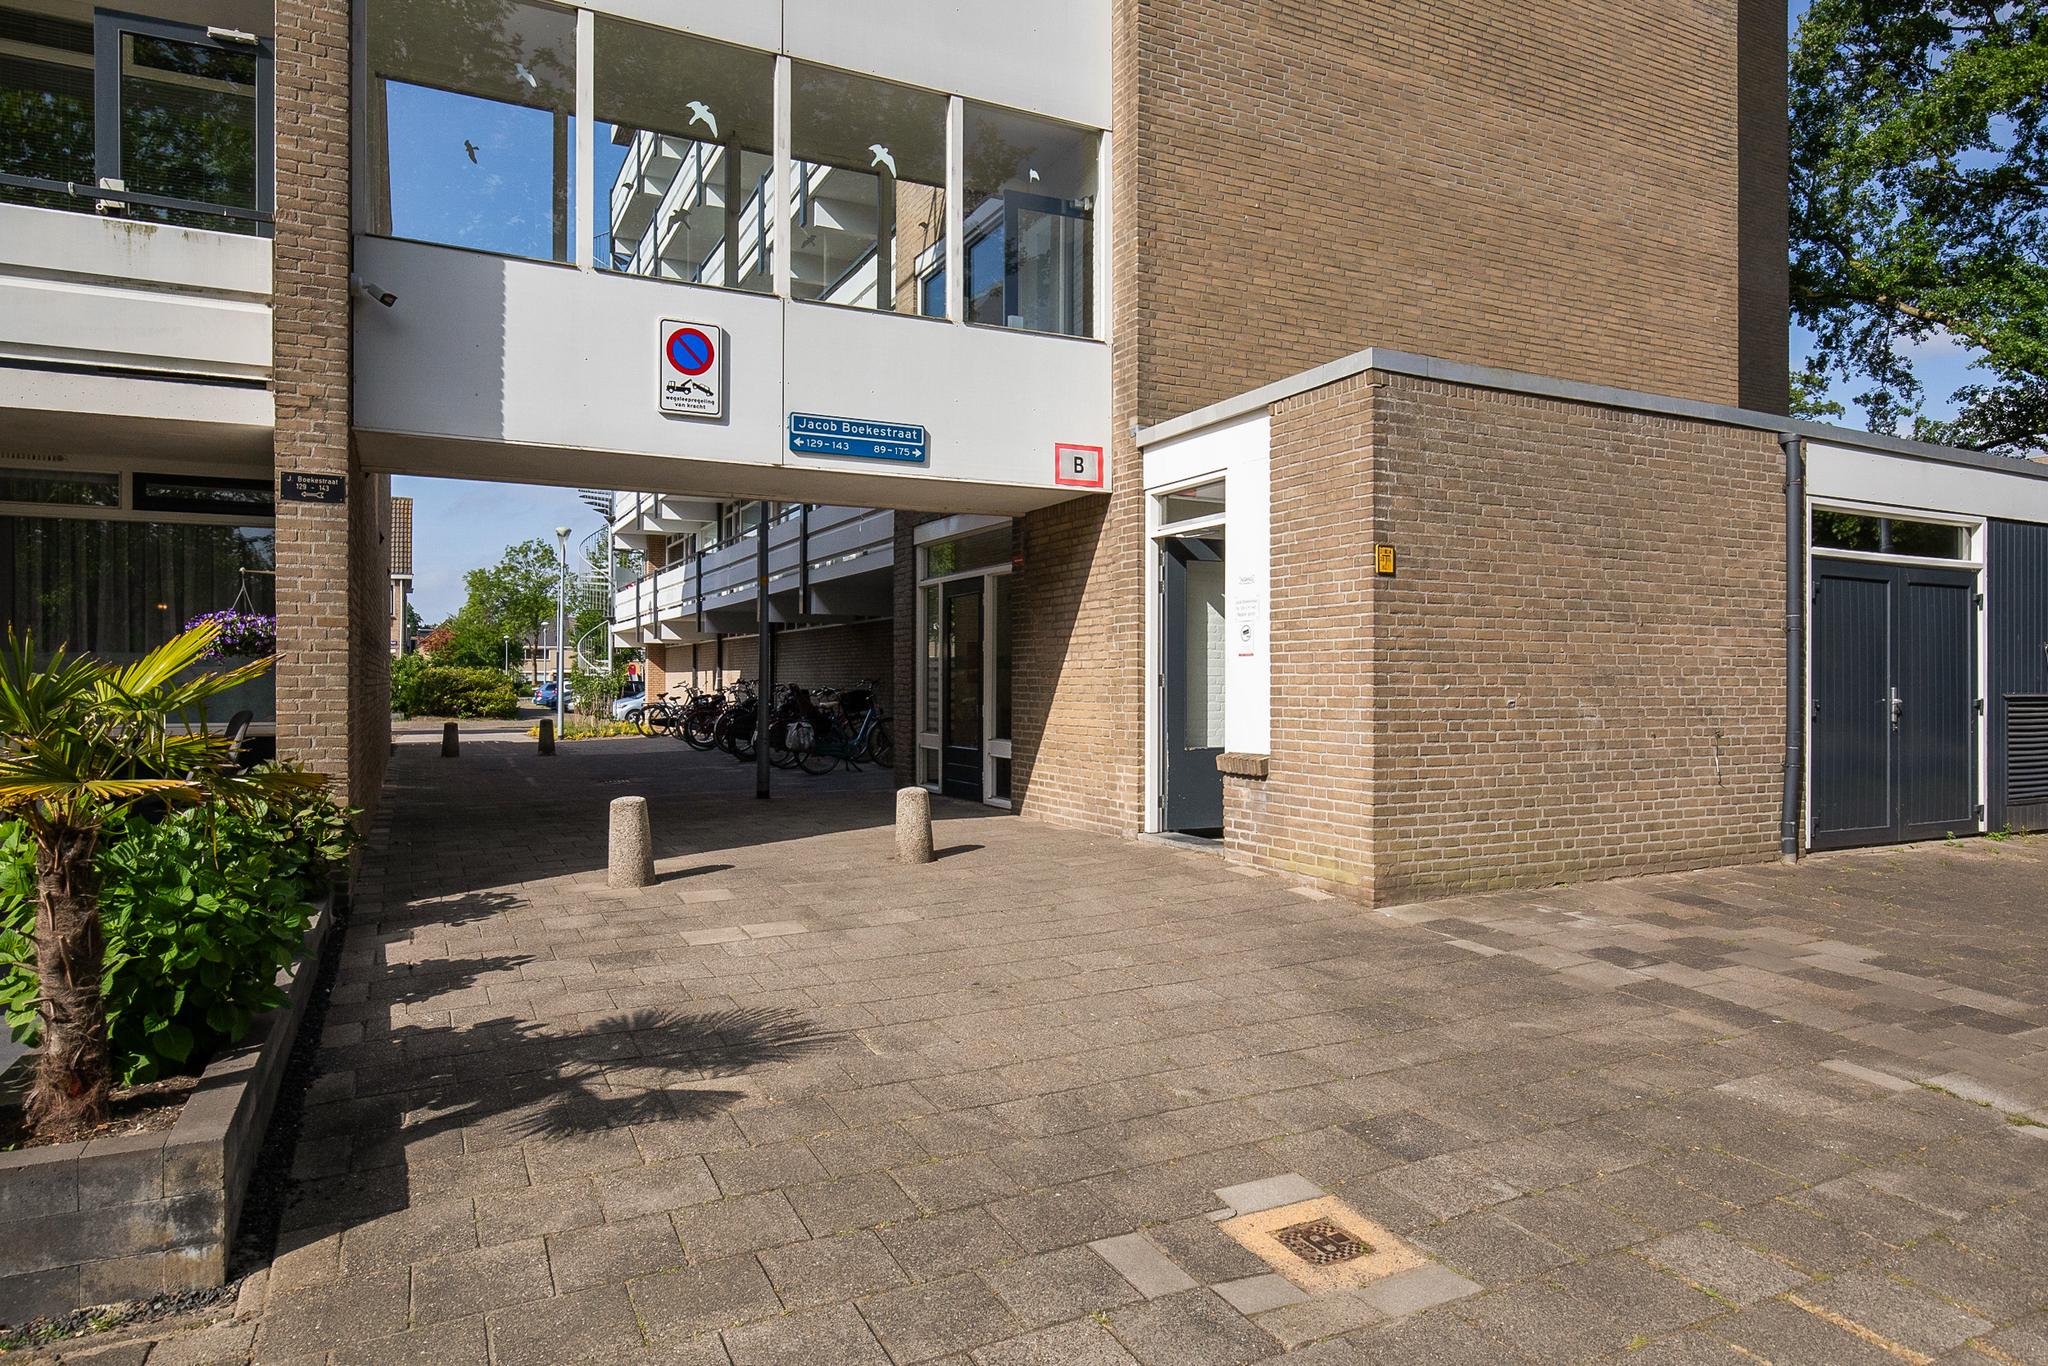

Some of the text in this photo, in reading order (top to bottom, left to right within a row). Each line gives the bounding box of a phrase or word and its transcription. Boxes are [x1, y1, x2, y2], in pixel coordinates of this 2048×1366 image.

[666, 396, 715, 405] wegsleepregeling
[799, 418, 918, 440] Jacob Boekestraat
[806, 438, 850, 451] 129-143
[873, 445, 910, 456] 89-175
[1074, 456, 1084, 473] B
[297, 475, 338, 485] Boekestraat
[319, 484, 330, 492] 143
